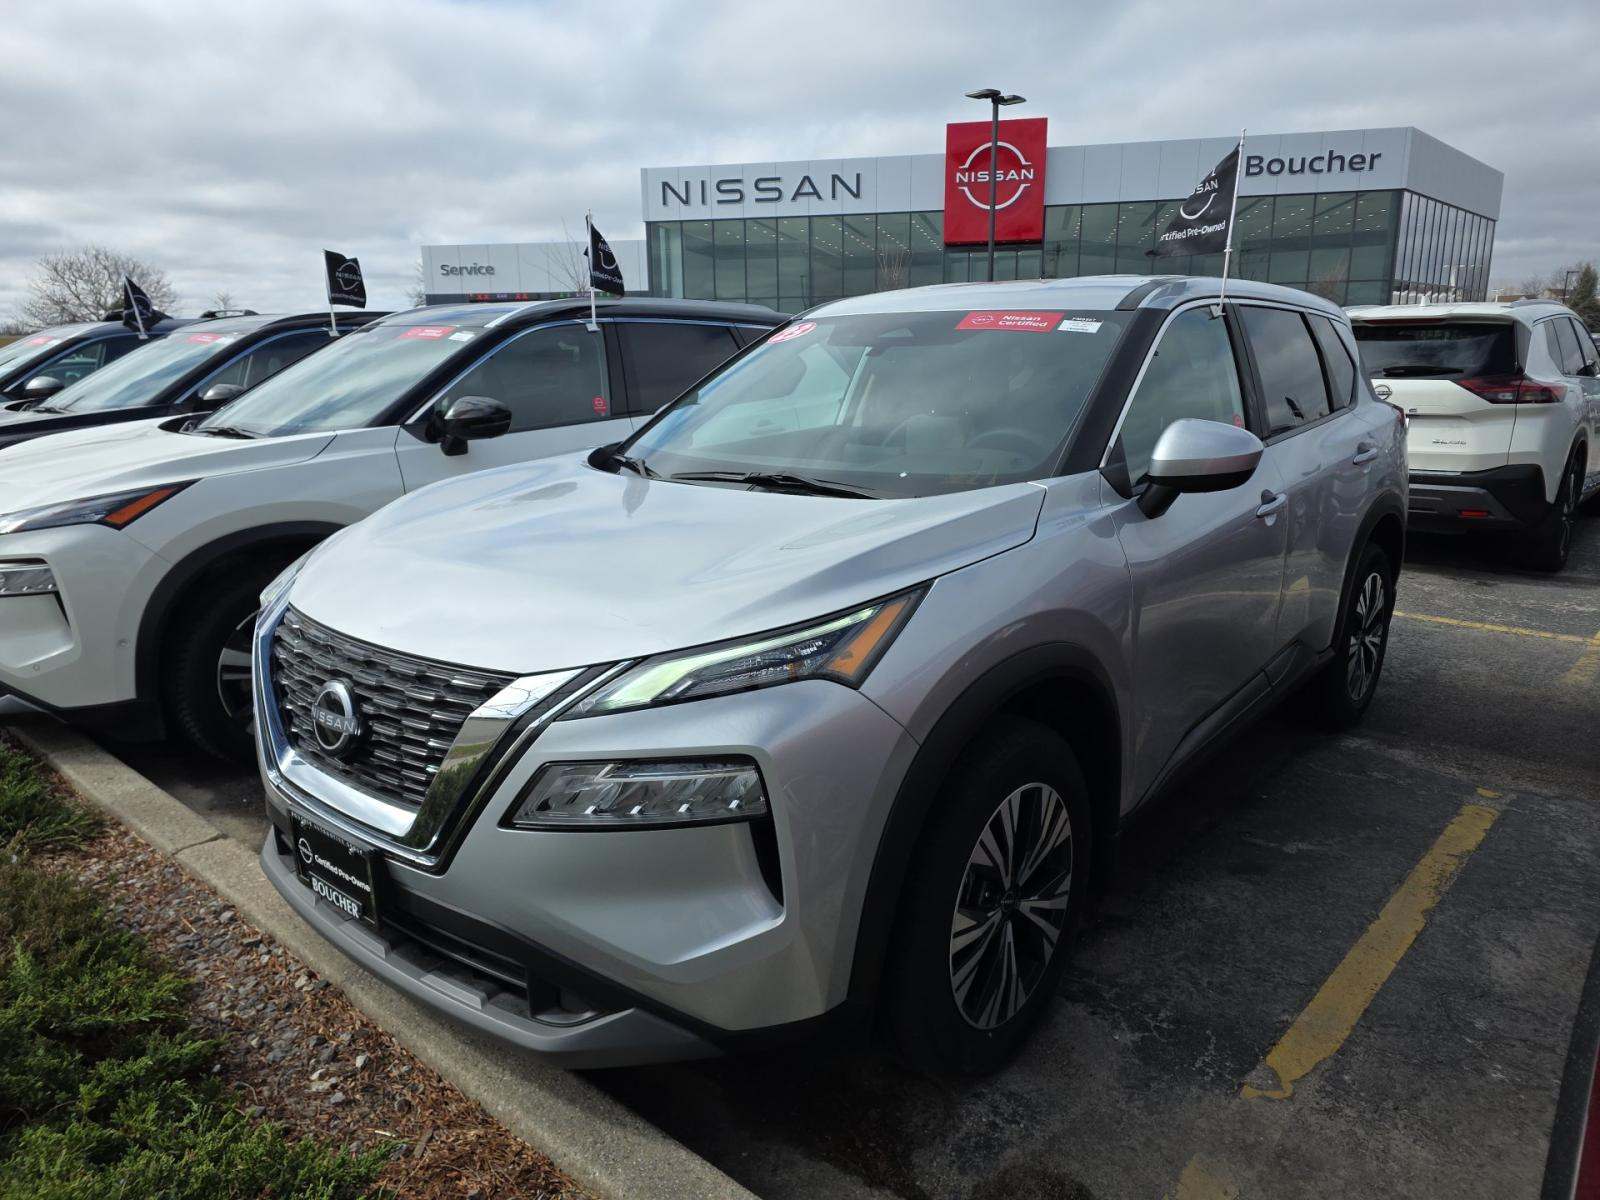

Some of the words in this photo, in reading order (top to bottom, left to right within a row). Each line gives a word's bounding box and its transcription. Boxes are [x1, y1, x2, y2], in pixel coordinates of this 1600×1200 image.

[1245, 149, 1382, 177] Boucher
[956, 168, 1034, 183] NISSAN
[661, 173, 862, 206] NISSAN
[1187, 220, 1226, 237] Pre-Owned
[440, 262, 496, 277] Service
[998, 320, 1048, 328] Certified
[1002, 314, 1041, 322] Nissan
[311, 703, 355, 733] NISSAN
[311, 877, 360, 919] BOUCHER
